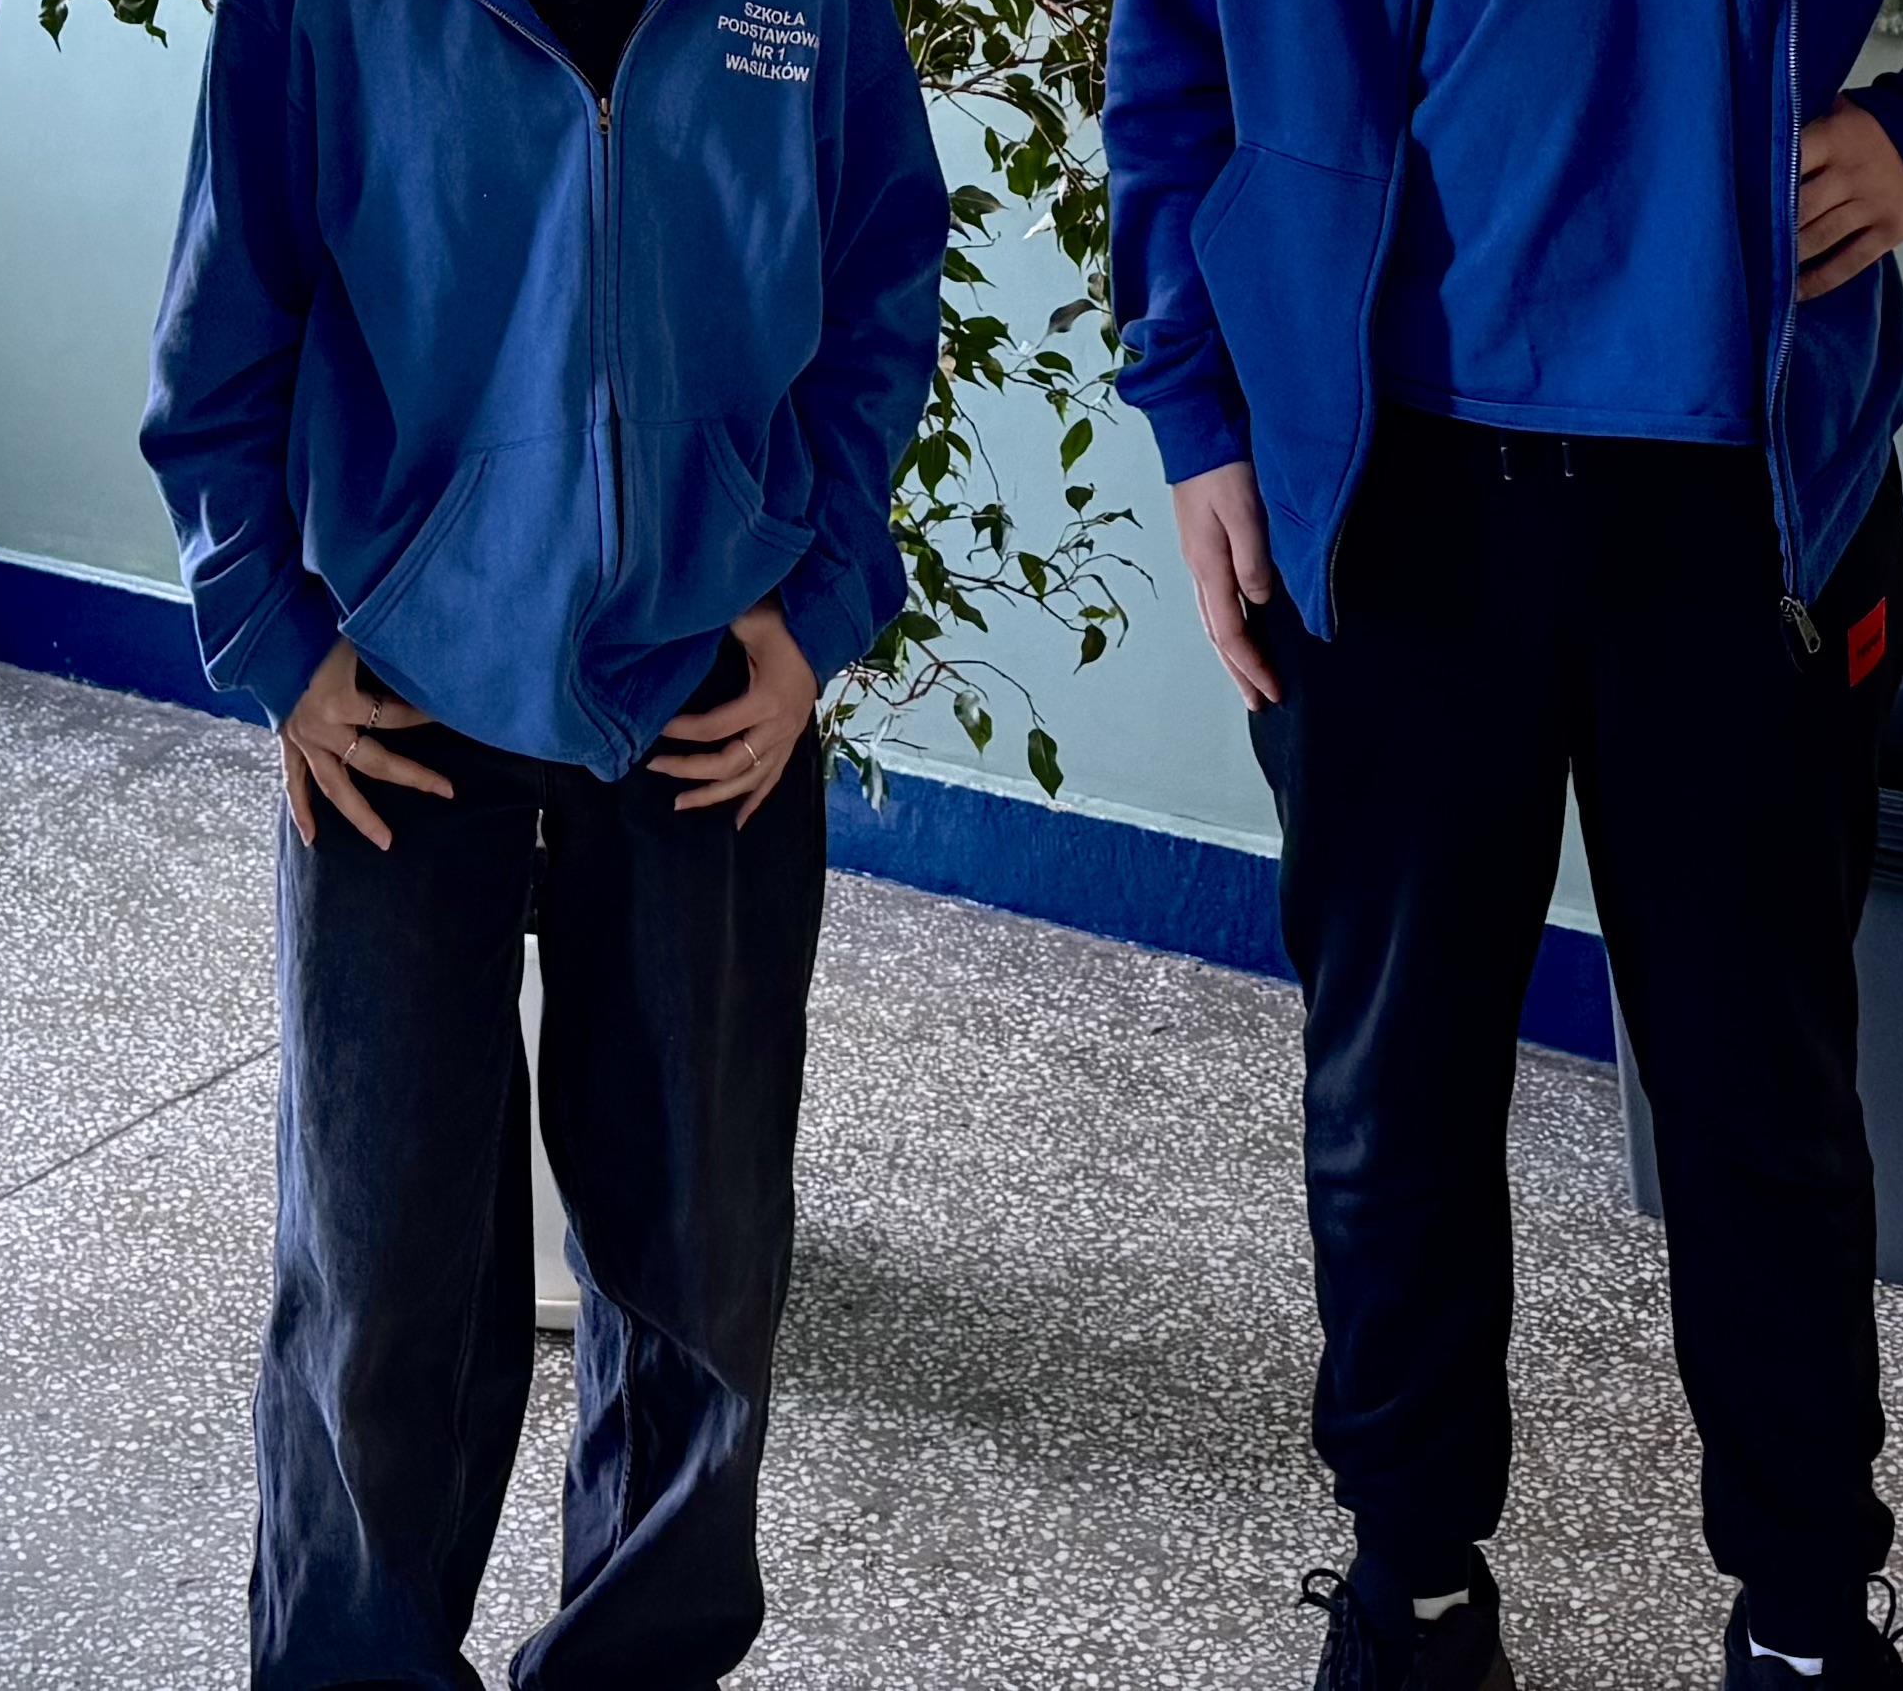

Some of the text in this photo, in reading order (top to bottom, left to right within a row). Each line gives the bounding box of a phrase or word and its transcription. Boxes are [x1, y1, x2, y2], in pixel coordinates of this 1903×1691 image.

[744, 1, 805, 26] SZKOŁA
[751, 42, 785, 61] NR 1
[725, 52, 810, 81] WASILKÓW
